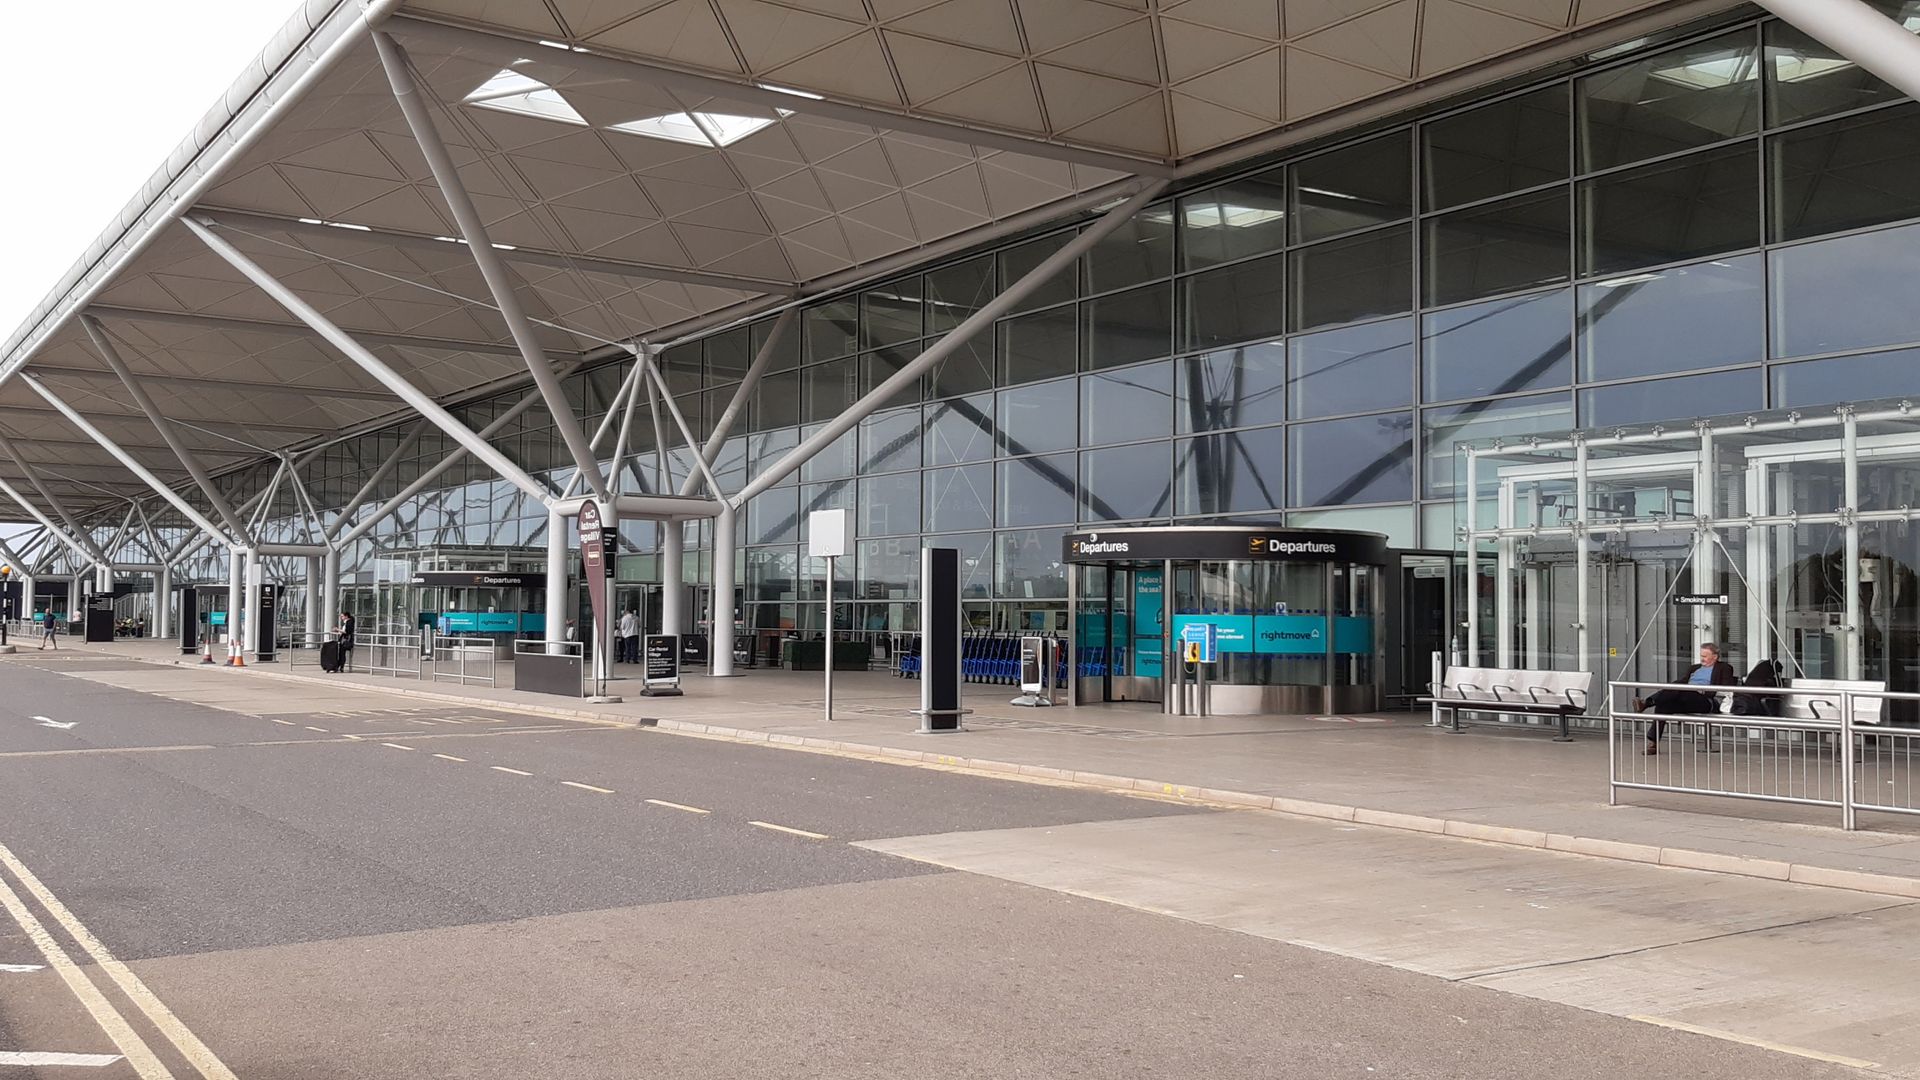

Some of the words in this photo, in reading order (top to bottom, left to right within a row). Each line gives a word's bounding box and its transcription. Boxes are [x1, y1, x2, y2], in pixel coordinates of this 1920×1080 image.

[1079, 541, 1129, 555] Departures
[1269, 539, 1336, 554] Departures
[484, 576, 522, 585] Departures
[1680, 596, 1705, 604] Smoking
[1261, 630, 1312, 641] rightmove
